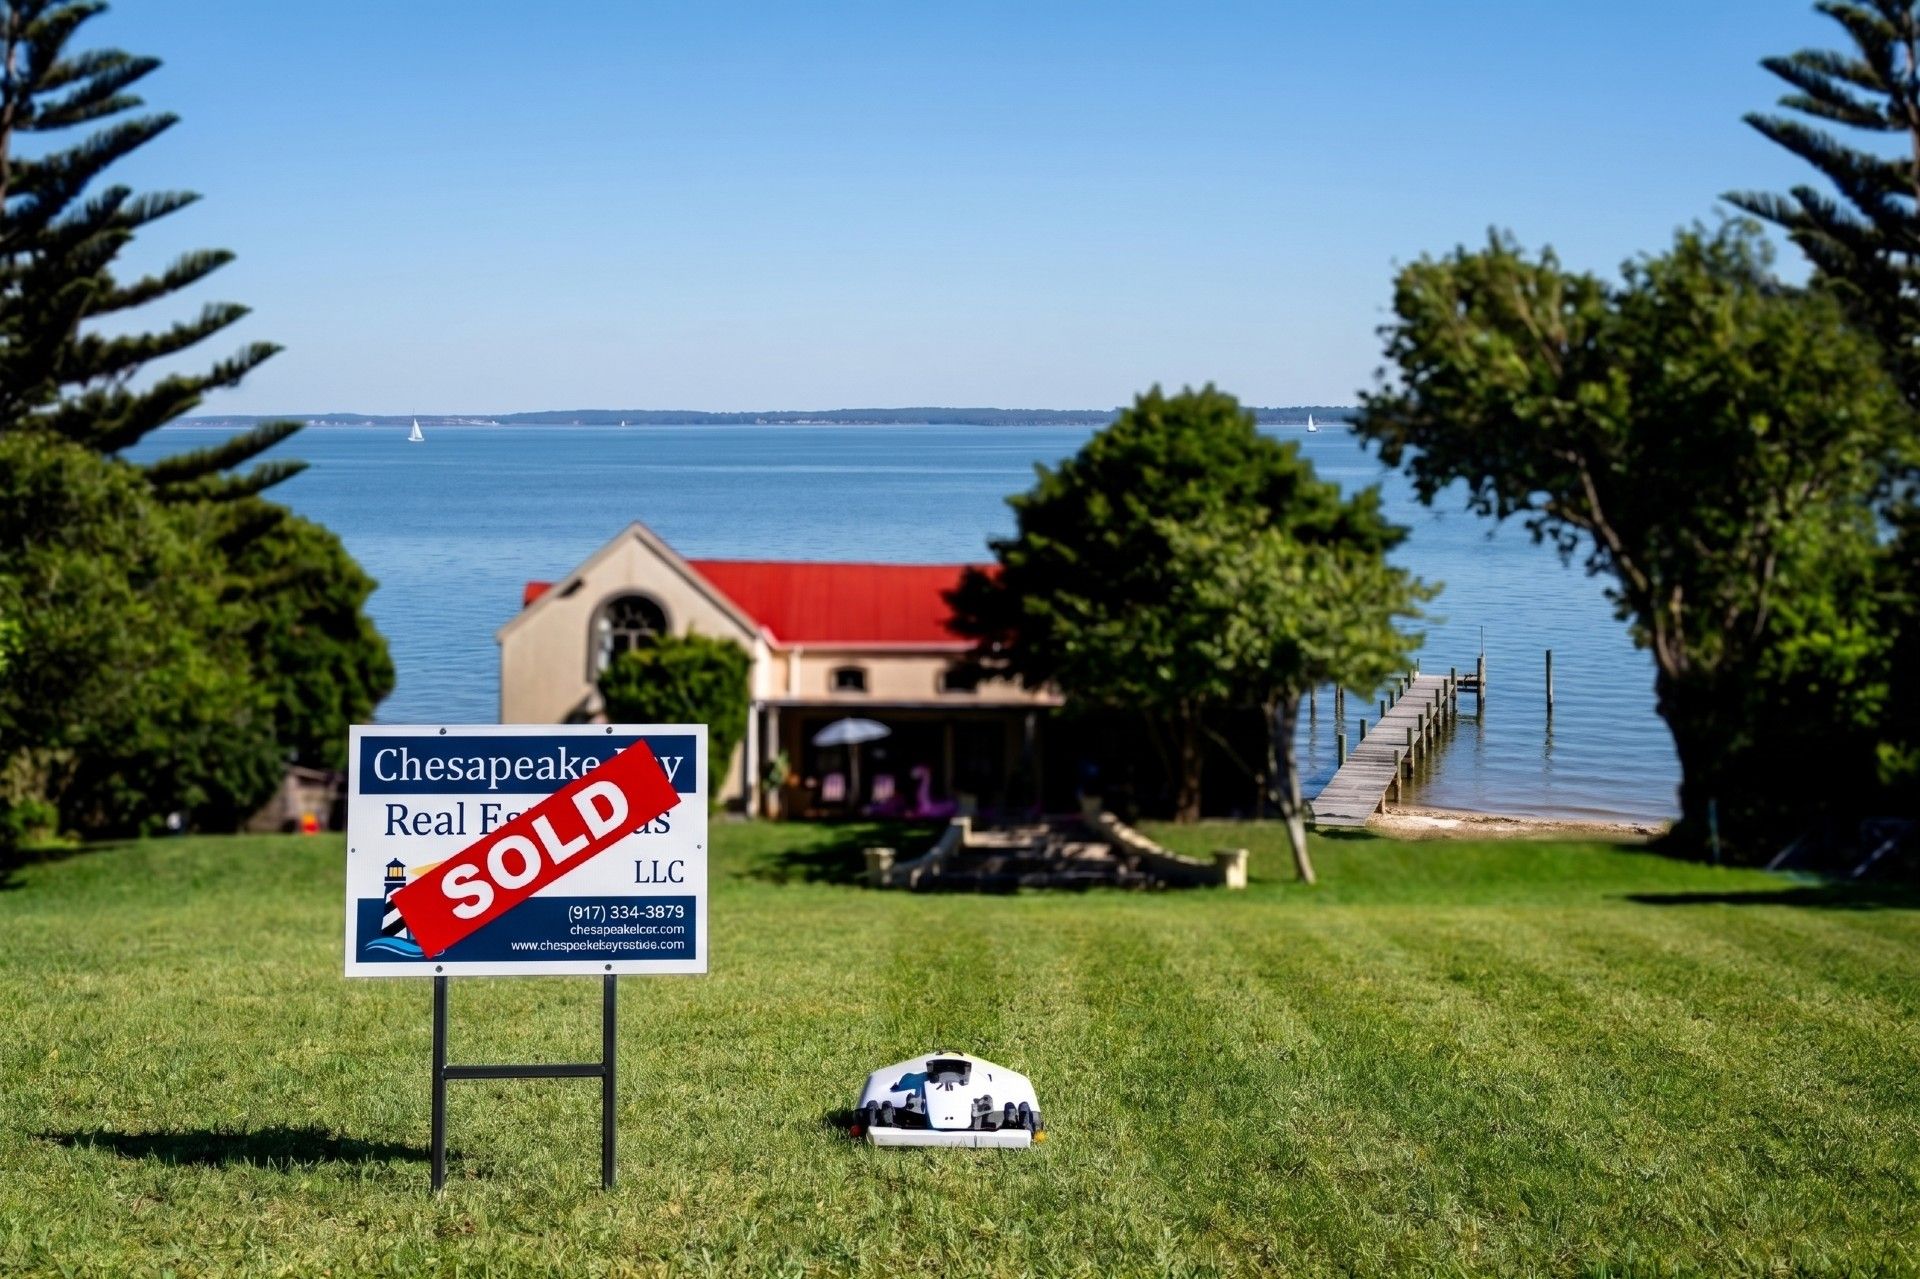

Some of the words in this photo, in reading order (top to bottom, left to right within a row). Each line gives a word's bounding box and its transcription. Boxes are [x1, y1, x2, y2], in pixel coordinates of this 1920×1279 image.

[374, 746, 601, 790] Chesapeake
[384, 801, 467, 836] Real
[441, 780, 629, 919] SOLD
[634, 860, 684, 884] LLC
[568, 905, 606, 923] (917)
[610, 905, 685, 919] 334-3879
